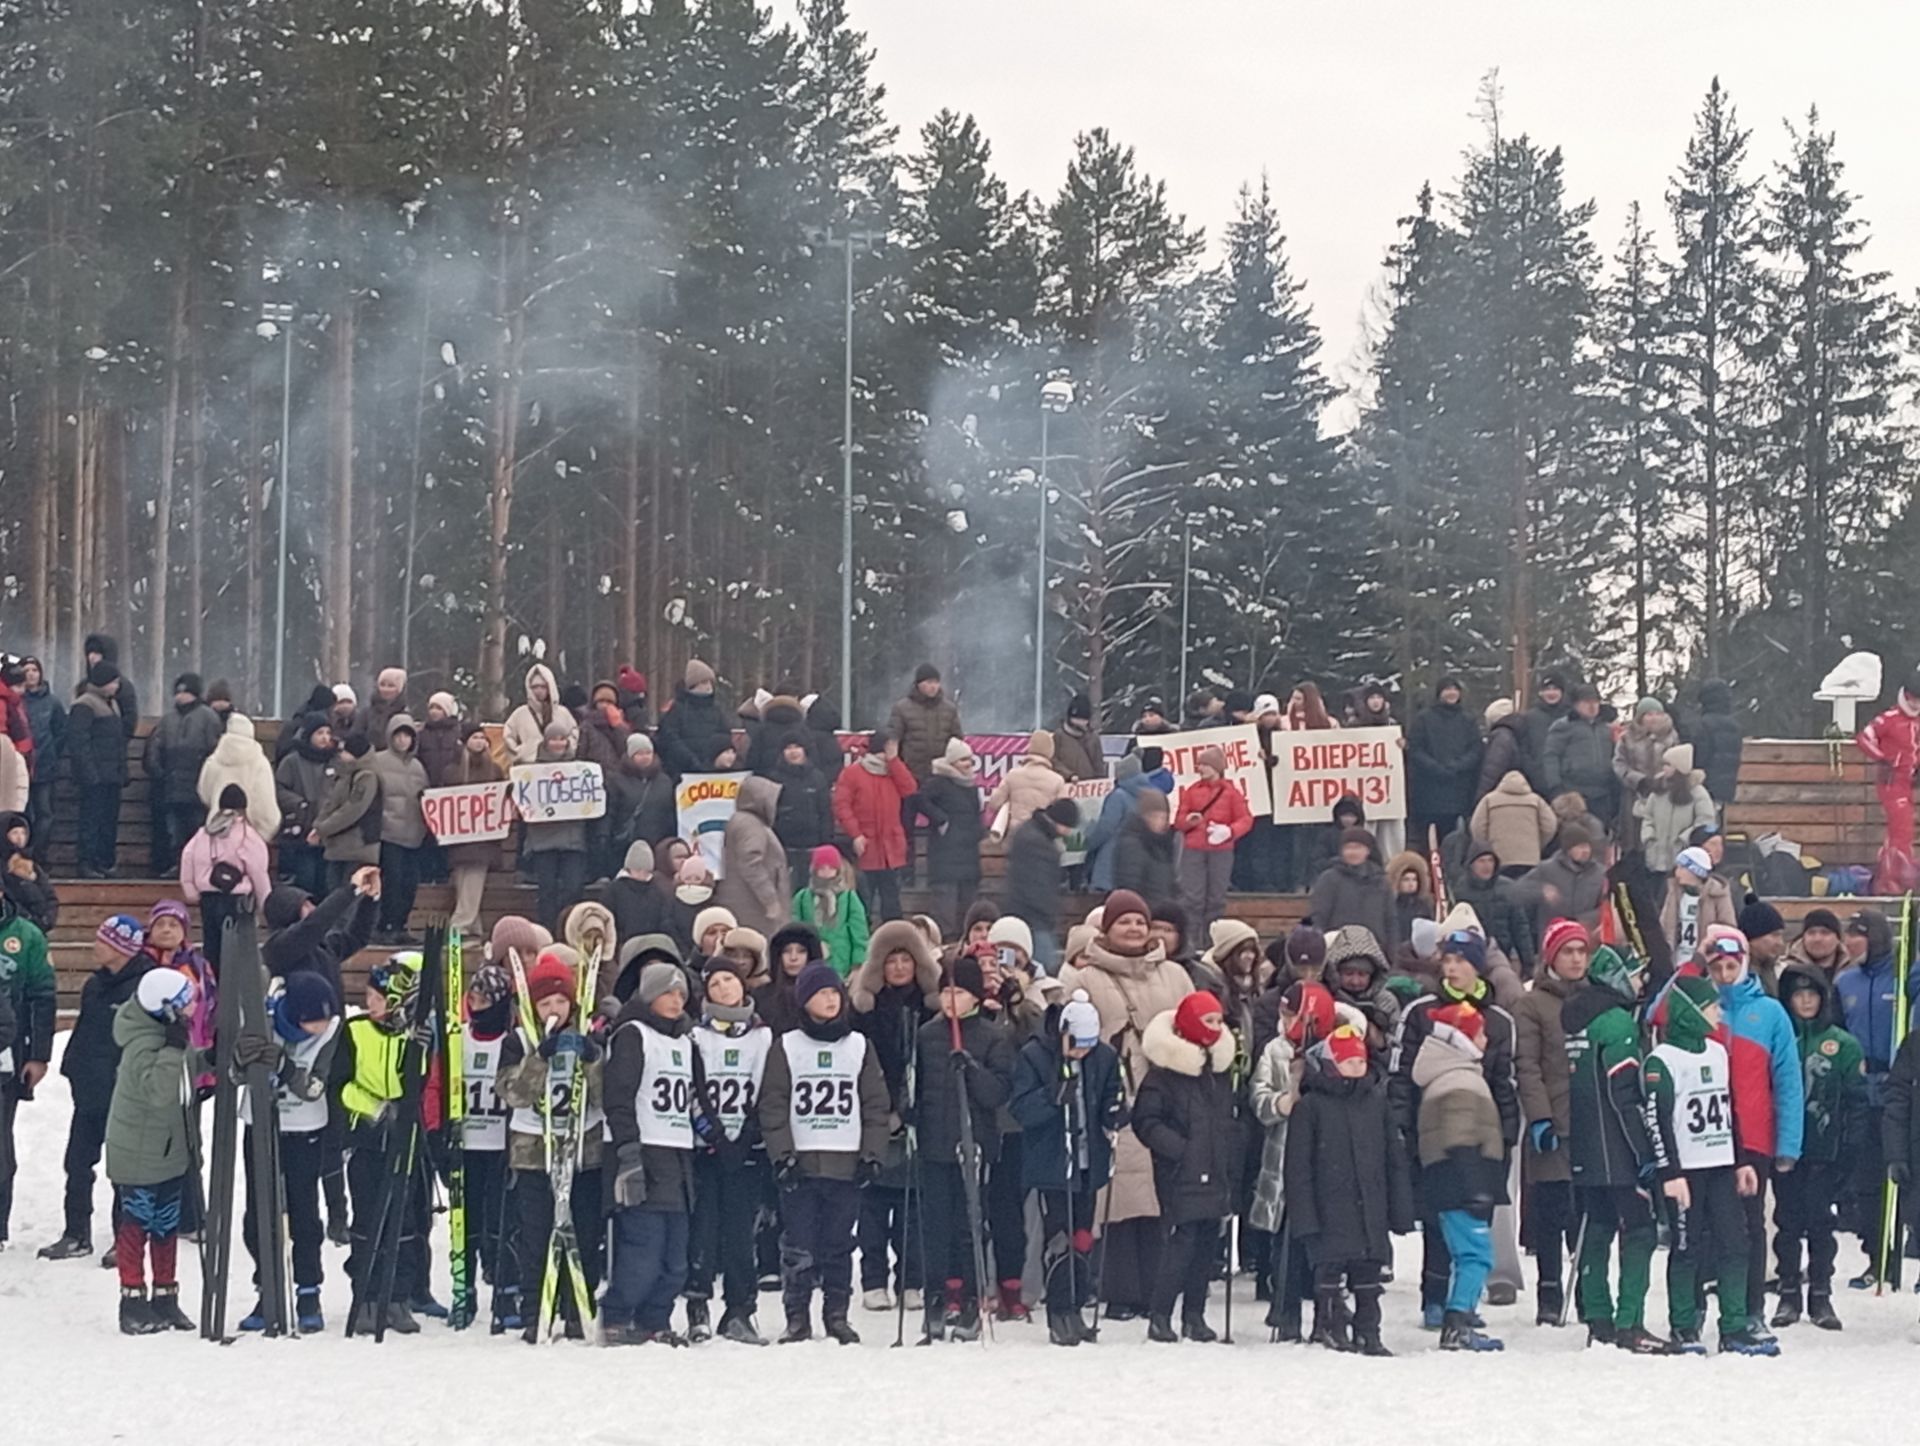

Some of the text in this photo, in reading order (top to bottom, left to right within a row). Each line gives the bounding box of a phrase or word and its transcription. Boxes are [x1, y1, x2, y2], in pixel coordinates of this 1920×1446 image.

[518, 774, 603, 804] К ПОБЕДЕ
[688, 782, 724, 802] СОШ
[1288, 775, 1391, 808] АГРЫЗ!
[794, 1079, 854, 1117] 325
